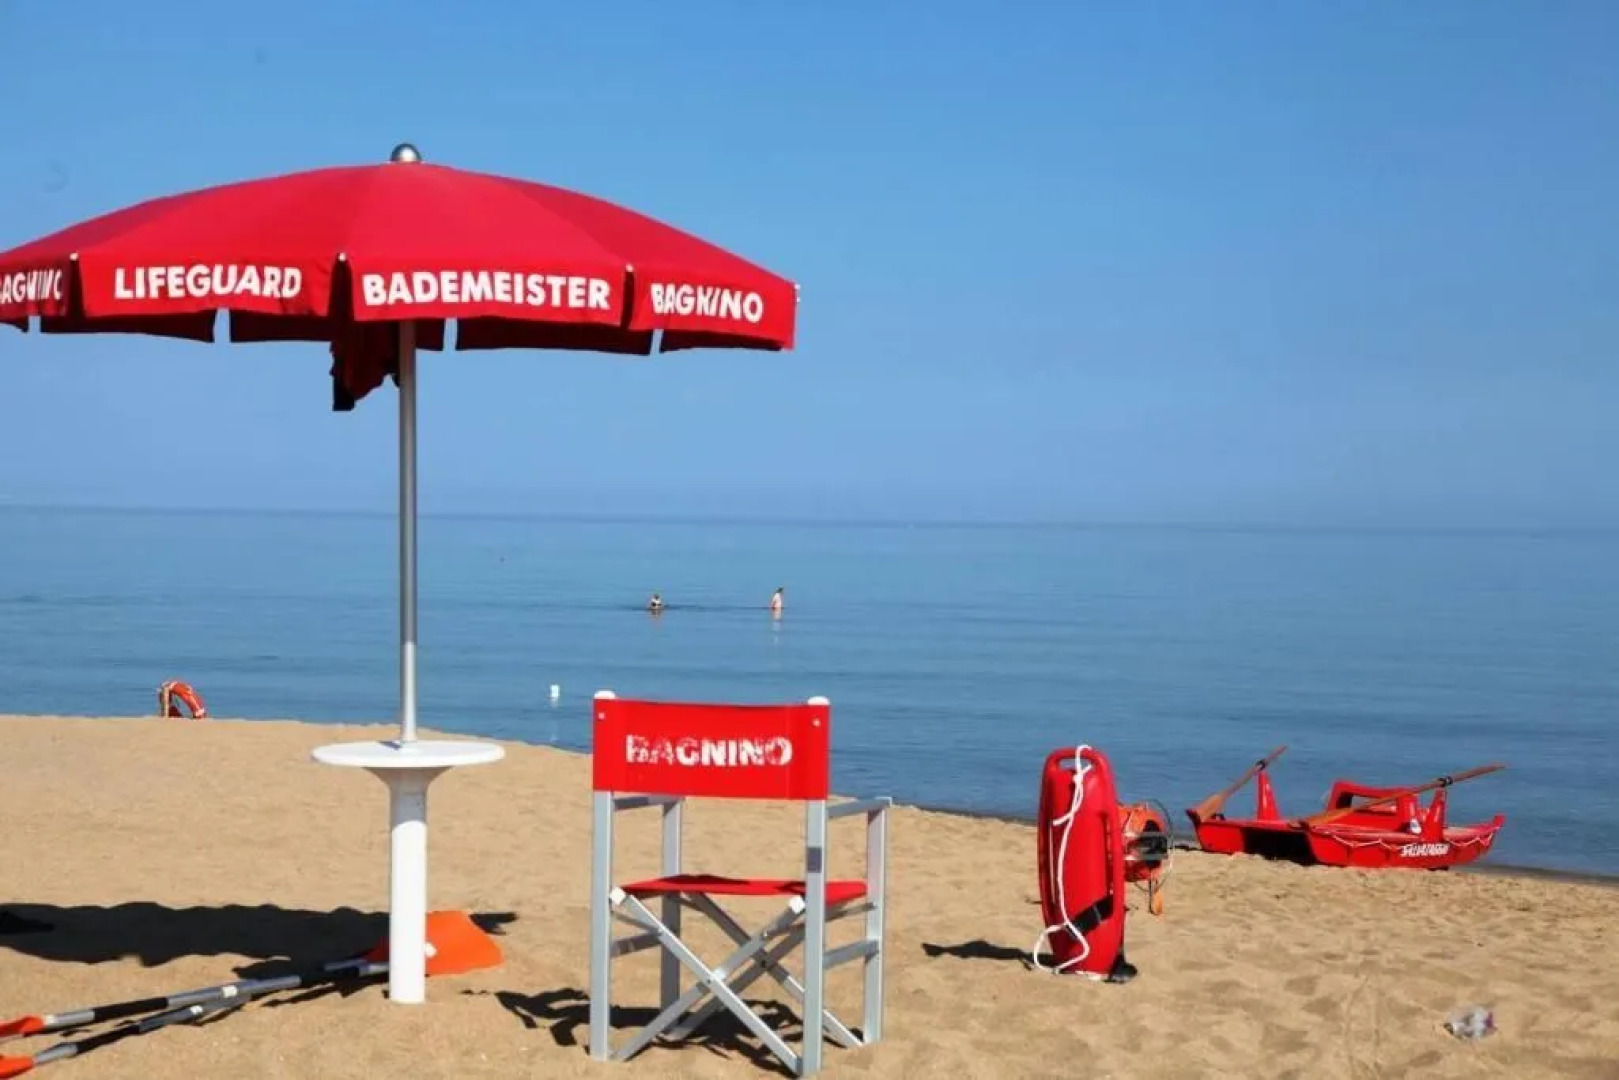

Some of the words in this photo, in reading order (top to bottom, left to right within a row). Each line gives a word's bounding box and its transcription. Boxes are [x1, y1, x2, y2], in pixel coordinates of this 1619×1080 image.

[114, 264, 302, 299] LIFEGUARD
[362, 270, 611, 310] BADEMEISTER
[651, 283, 763, 323] BAGNINO
[625, 734, 793, 767] BAGNINO
